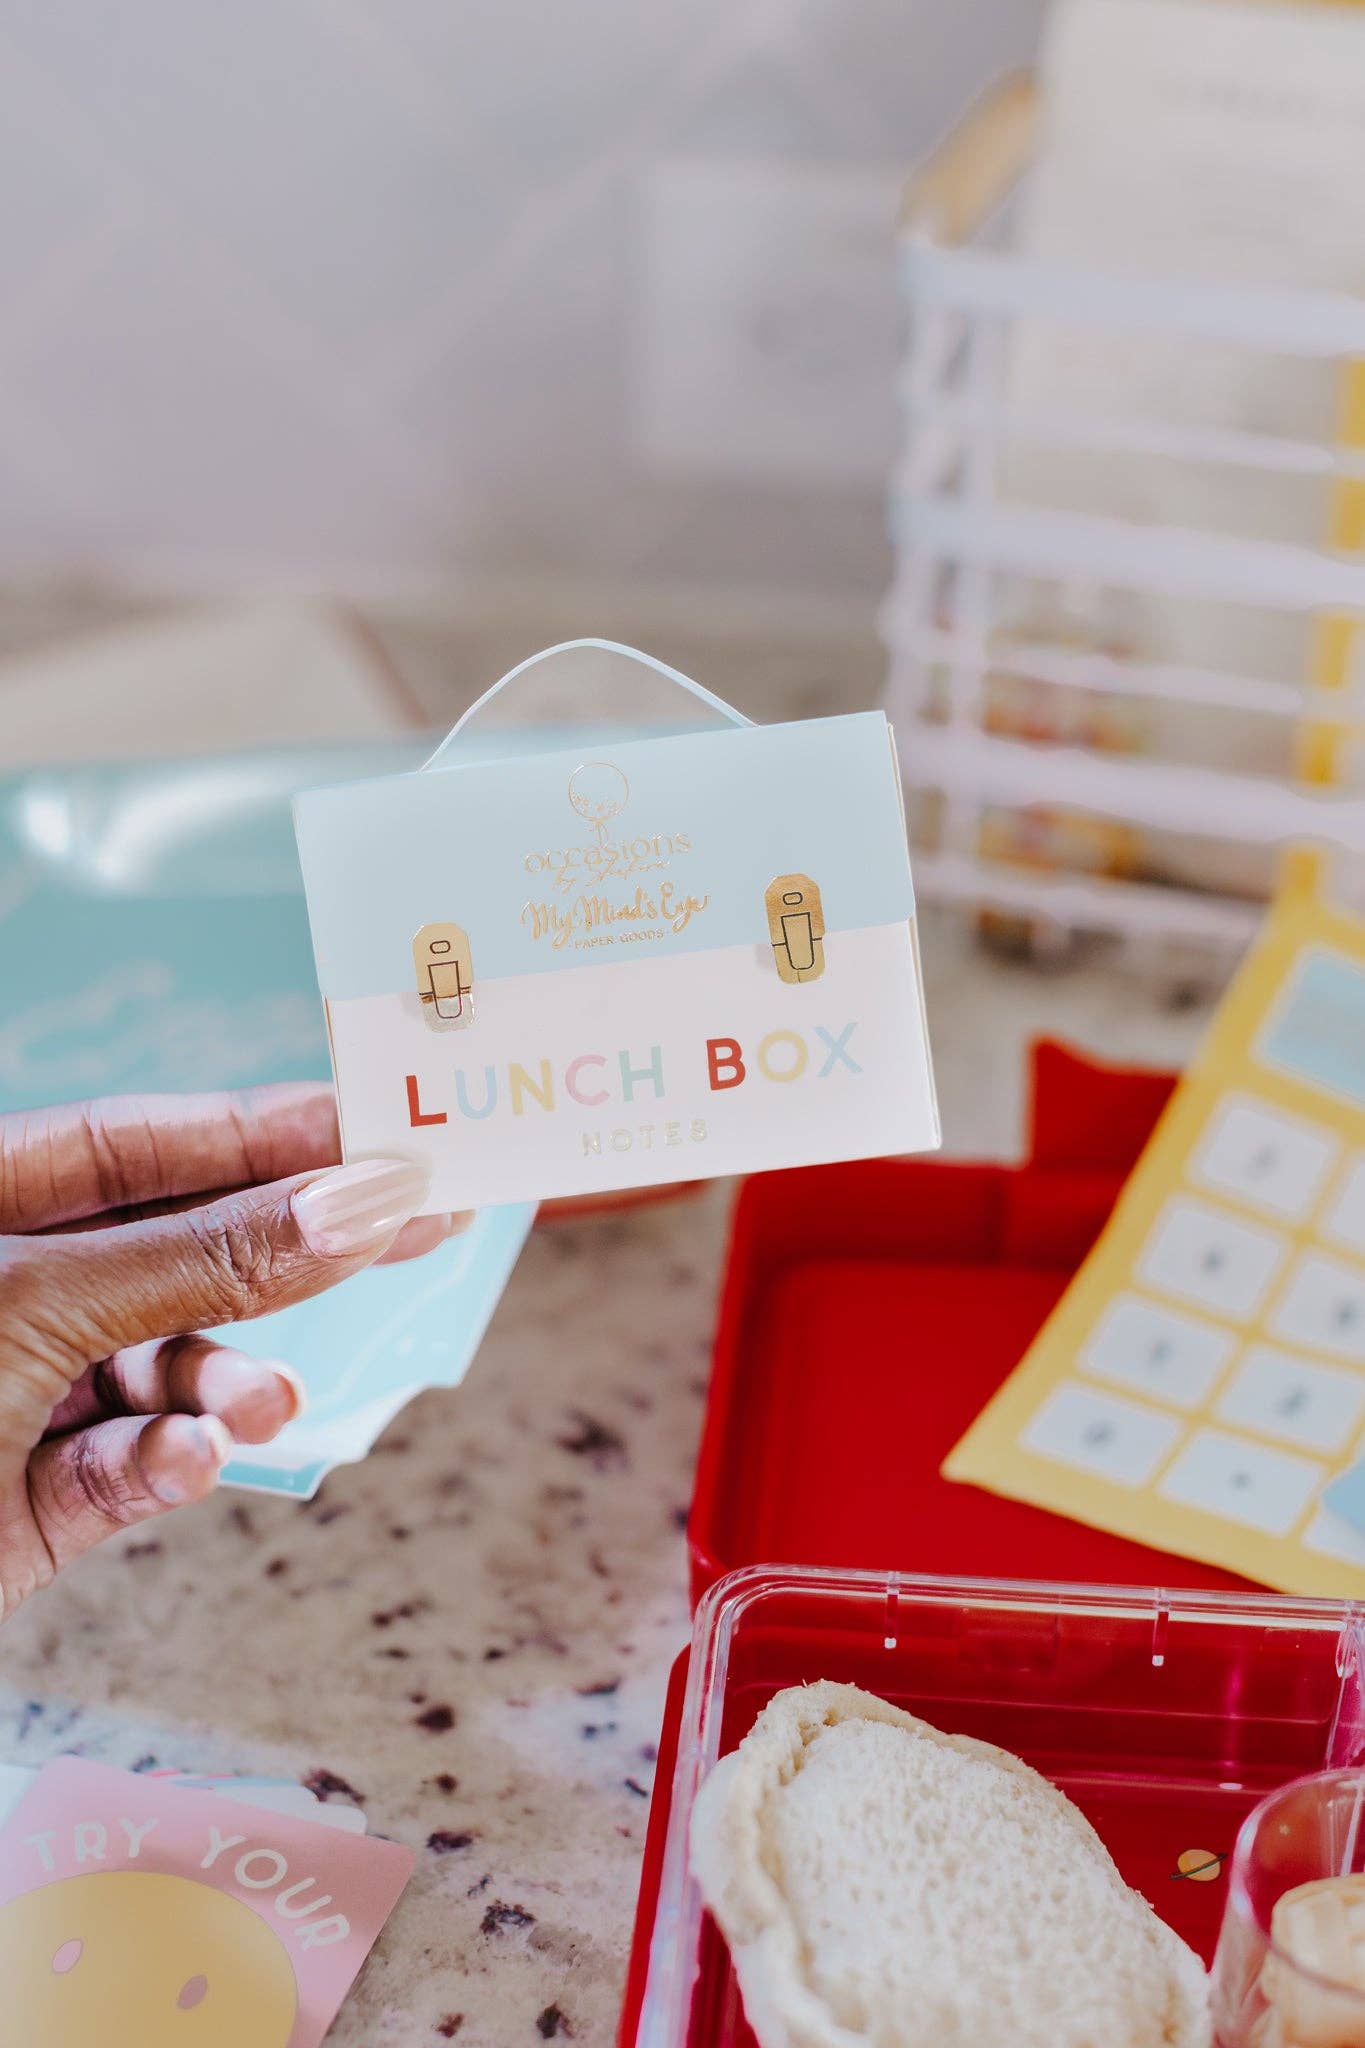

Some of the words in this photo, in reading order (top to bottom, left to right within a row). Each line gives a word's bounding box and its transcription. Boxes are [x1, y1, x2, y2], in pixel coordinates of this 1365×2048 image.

[520, 902, 573, 949] My
[659, 881, 709, 933] Eye
[618, 928, 666, 944] GOODS
[405, 1045, 665, 1127] LUNCH
[706, 1021, 864, 1091] BOX
[581, 1118, 708, 1157] NOTES
[23, 1817, 158, 1871] TRY
[200, 1826, 350, 1950] YOUR
